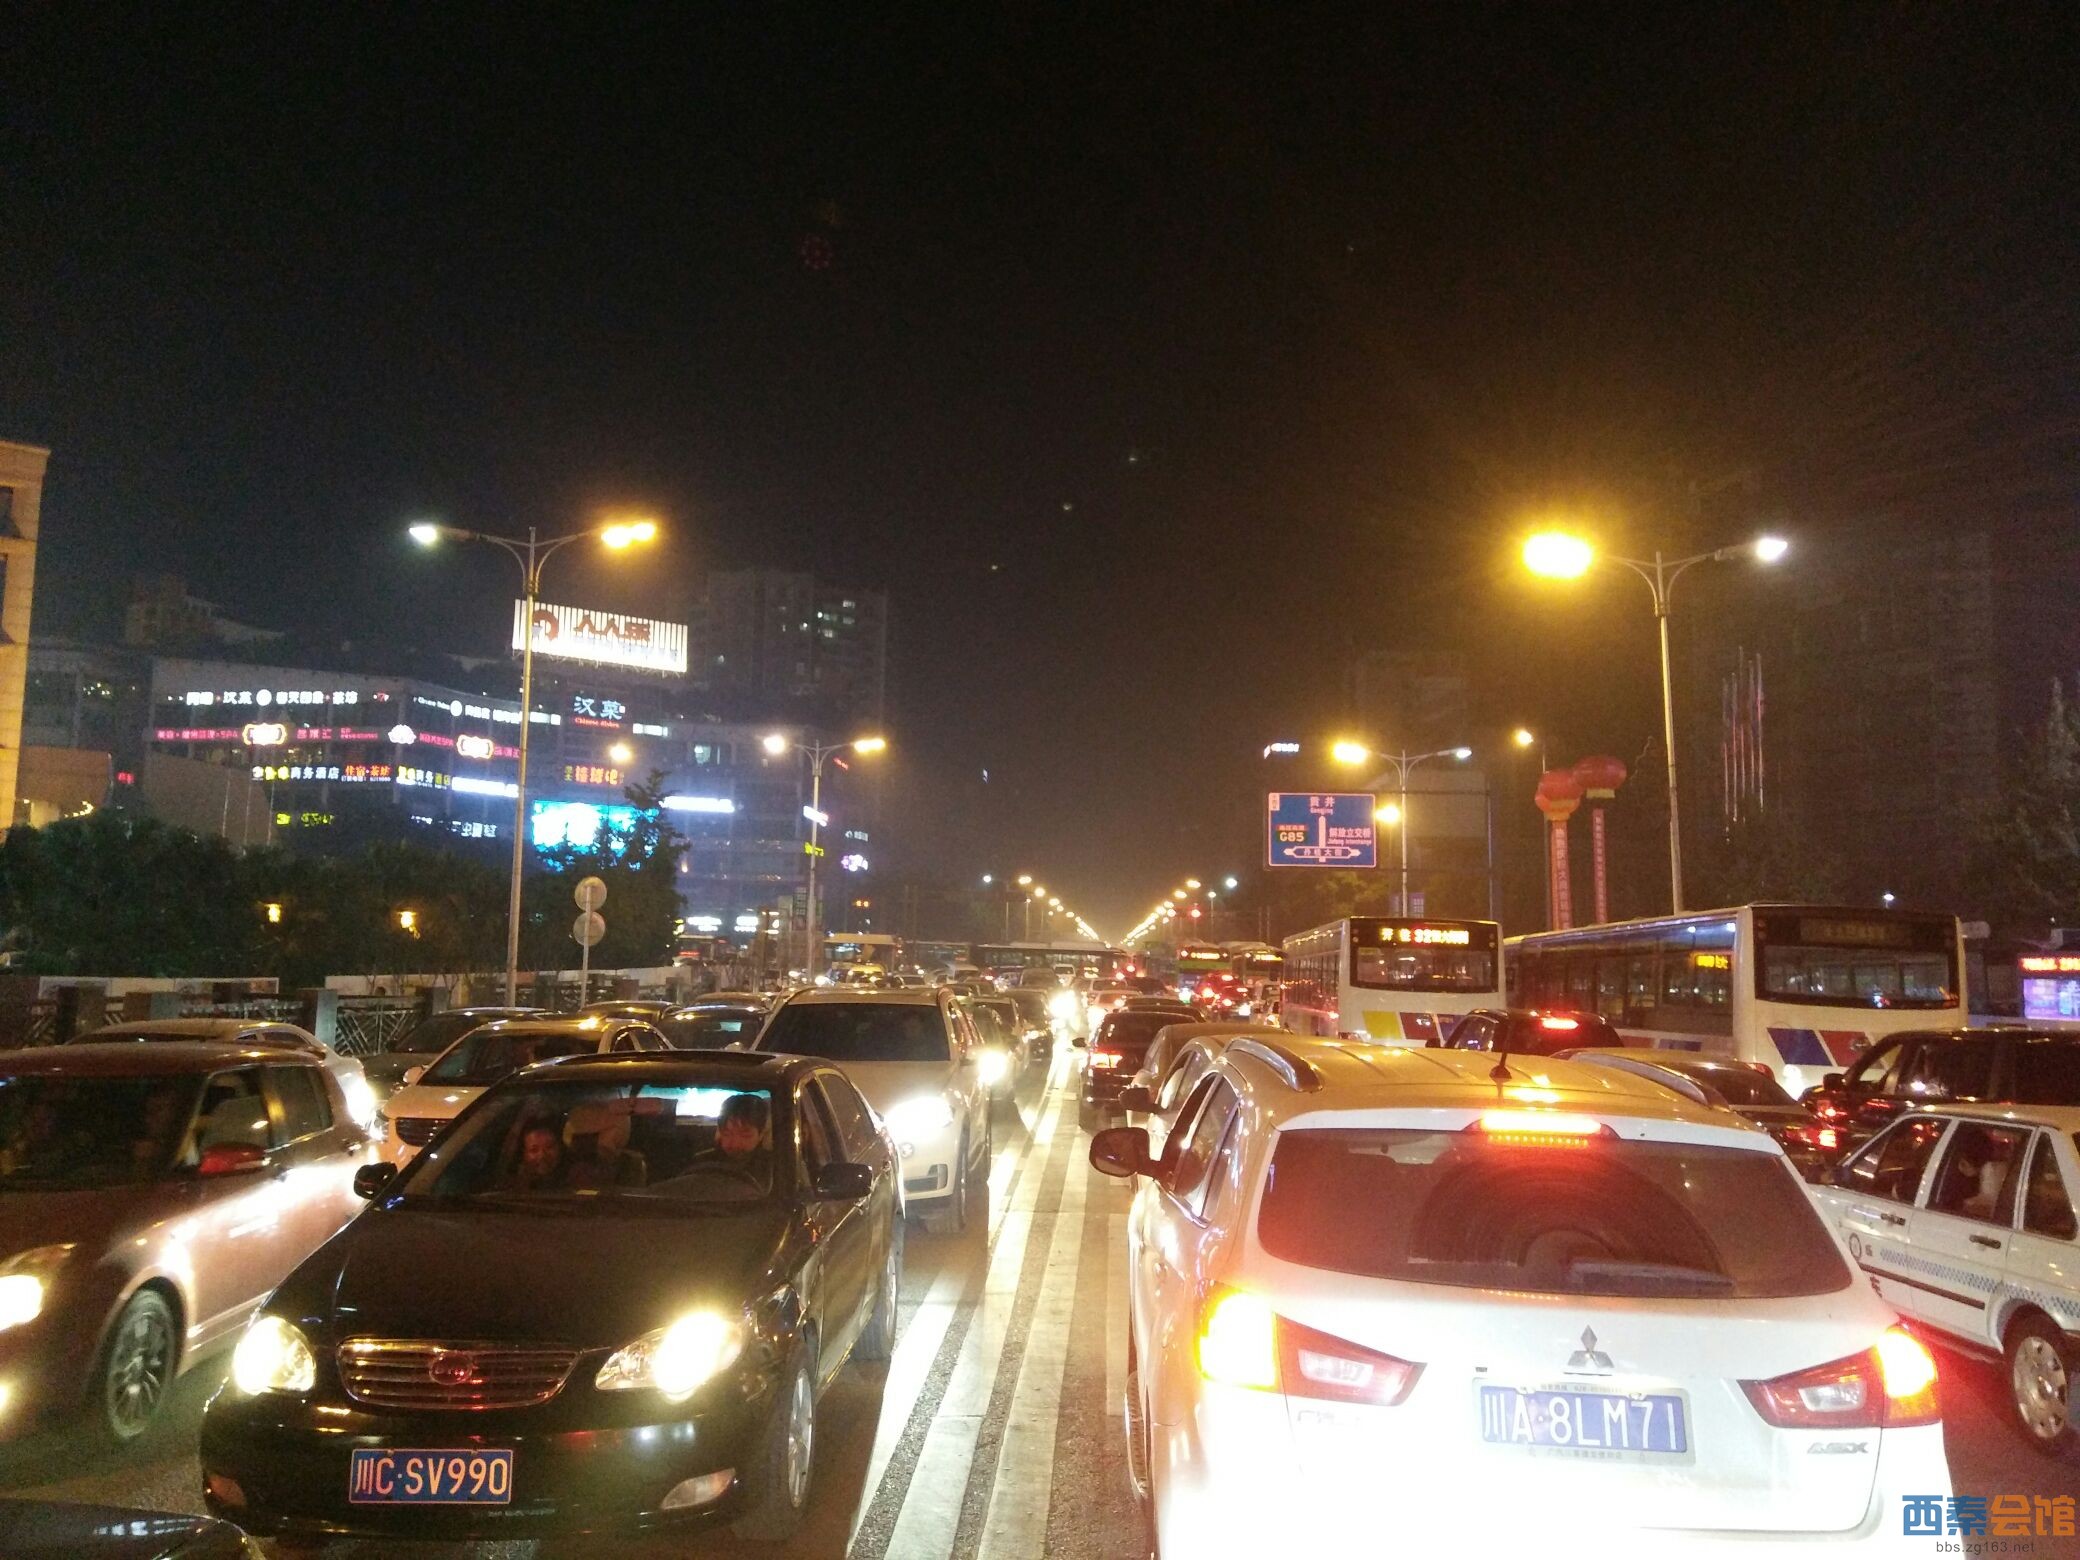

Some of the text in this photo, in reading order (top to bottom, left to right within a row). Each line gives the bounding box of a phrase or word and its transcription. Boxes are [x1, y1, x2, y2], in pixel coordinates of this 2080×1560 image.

[574, 696, 622, 720] 汉菜
[1279, 832, 1305, 842] G85
[1484, 1393, 1677, 1450] 川A·8LM71
[355, 1458, 508, 1495] 川C·SV990
